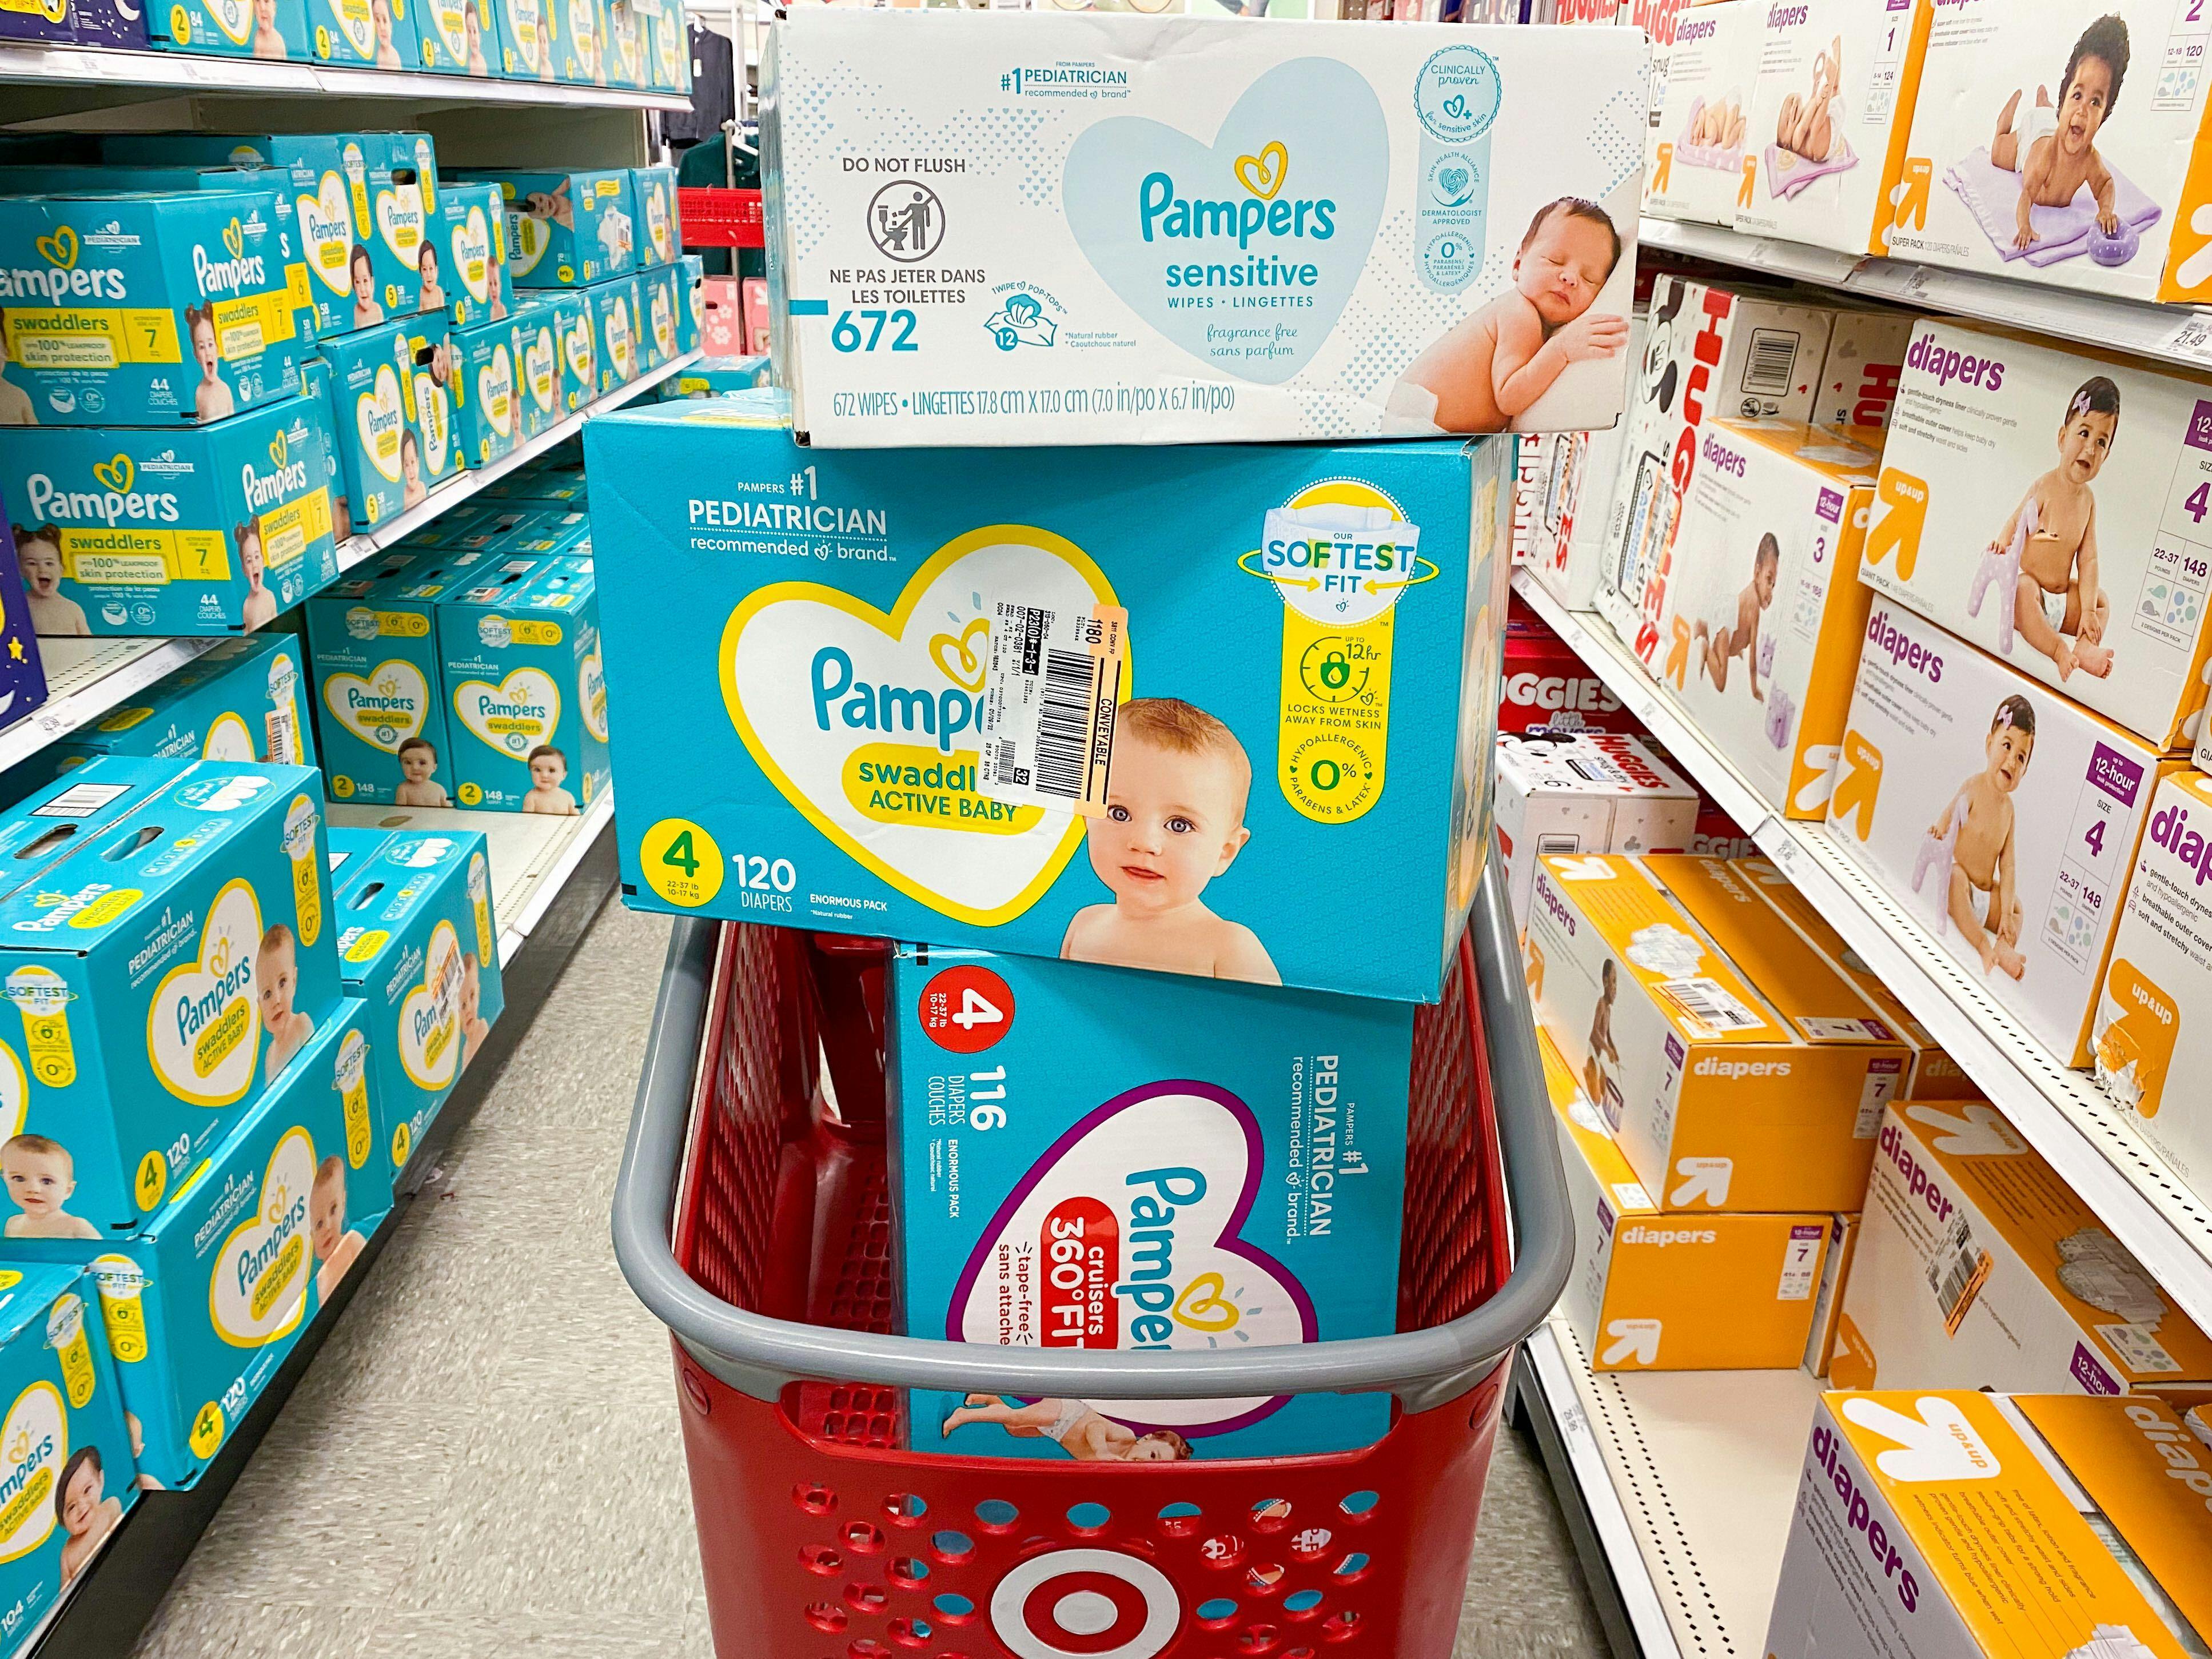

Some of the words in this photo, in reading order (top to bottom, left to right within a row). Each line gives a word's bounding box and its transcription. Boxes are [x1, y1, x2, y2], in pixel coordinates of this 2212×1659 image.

[1001, 68, 1022, 94] #1
[1025, 69, 1127, 84] PEDIATRICIAN
[1431, 65, 1486, 74] CLINICALLY
[1438, 75, 1480, 88] proven
[1025, 88, 1087, 98] recommended
[1425, 110, 1437, 125] for
[1438, 122, 1472, 133] sensitive
[1472, 113, 1487, 128] skin
[843, 158, 869, 173] DO
[874, 158, 909, 173] NOT
[915, 158, 966, 173] FLUSH
[1428, 165, 1437, 182] SKIN
[1436, 152, 1459, 165] HEALTH
[1460, 153, 1480, 183] ALLIANCE
[1140, 172, 1336, 250] Pampers
[193, 244, 265, 297] Pampers
[830, 270, 852, 284] NE
[857, 270, 886, 284] PAS
[891, 270, 936, 284] JETER
[942, 270, 986, 284] DANS
[1166, 255, 1318, 288] sensitive
[0, 268, 126, 306] ampers
[852, 290, 879, 304] LES
[886, 290, 966, 304] TOILETTES
[1167, 297, 1214, 308] WIPES
[1233, 296, 1314, 308] LINGETTES
[14, 314, 109, 331] swaddlers
[831, 310, 918, 353] 672
[1207, 324, 1270, 342] fragrance
[1274, 323, 1298, 341] free
[2174, 330, 2207, 346] 21.49
[998, 332, 1015, 346] 12
[1070, 340, 1111, 348] Caoutchouc
[1210, 345, 1241, 357] sans
[1246, 342, 1294, 360] parfum
[1908, 333, 2004, 391] diapers
[834, 392, 855, 417] 672
[858, 392, 897, 416] WIPES
[912, 391, 974, 416] LINGETTES
[977, 391, 998, 415] 17.8
[1001, 390, 1025, 414] cm
[1040, 390, 1061, 413] 17.0
[1065, 389, 1088, 413] cm
[1092, 388, 1113, 414] (7.0
[1117, 381, 1154, 416] in/po
[1171, 387, 1187, 410] 6.7
[1192, 380, 1234, 414] in/po)
[1703, 432, 1747, 478] diapers
[242, 460, 306, 513] Pampers
[738, 482, 785, 494] PAMPERS
[790, 465, 818, 501] #1
[26, 474, 179, 527] Pampers
[688, 499, 886, 535] PEDIATRICIAN
[70, 534, 161, 551] swaddlers
[691, 537, 808, 557] recommended
[1333, 533, 1353, 541] OUR
[1267, 540, 1415, 572] SOFTEST
[2184, 556, 2207, 578] 148
[80, 569, 103, 579] skin
[105, 569, 164, 580] protection
[1325, 575, 1362, 593] FIT
[201, 594, 218, 605] 44
[1085, 619, 1103, 644] 1180
[1868, 611, 1944, 683] diapers
[348, 688, 414, 711] Pampers
[478, 695, 545, 719] Pampers
[811, 647, 984, 751] Pamp
[1499, 673, 1623, 712] GGIES
[488, 721, 541, 732] swaddlers
[1285, 715, 1316, 725] AWAY
[1320, 718, 1351, 728] FROM
[1356, 720, 1381, 729] SKIN
[1288, 704, 1325, 715] LOCKS
[1329, 707, 1380, 718] WETNESS
[1094, 699, 1113, 766] CONVEYABLE
[1291, 733, 1372, 769] HYPOALLERGENIC
[357, 782, 374, 793] 148
[859, 762, 975, 791] swaddl
[1015, 769, 1029, 784] 32
[1311, 760, 1357, 791] 0%
[2096, 756, 2135, 792] 12-hour
[484, 790, 502, 800] 148
[870, 790, 950, 816] ACTIVE
[960, 799, 1017, 822] BABY
[1290, 776, 1332, 815] PARABENS
[2097, 799, 2111, 814] SIZE
[663, 830, 700, 878] 4
[2085, 820, 2106, 858] 4
[667, 880, 688, 890] 22-37
[691, 882, 699, 890] lb
[732, 854, 796, 893] 120
[2059, 871, 2080, 890] 22-37
[2149, 868, 2189, 901] gentle-touch
[668, 888, 688, 897] 10-17
[690, 890, 699, 900] kg
[741, 891, 792, 912] DIAPERS
[810, 893, 862, 908] ENORMOUS
[863, 898, 887, 911] PACK
[1536, 874, 1576, 938] diapers
[2082, 886, 2102, 909] 148
[2138, 909, 2150, 924] soft
[2151, 919, 2163, 933] and
[2163, 927, 2190, 954] stretchy
[2142, 893, 2175, 924] breathable
[2175, 915, 2193, 936] outer
[2194, 930, 2212, 952] cover
[129, 911, 193, 975] PEDIATRICIAN
[9, 986, 67, 999] SOFTEST
[176, 956, 250, 1046] Pampers
[2133, 982, 2173, 1026] up&up
[952, 988, 1003, 1030] 4
[197, 1004, 245, 1060] swaddlers
[1693, 1056, 1791, 1080] diapers
[928, 1076, 946, 1126] COUCHES
[948, 1075, 965, 1125] DIAPERS
[970, 1064, 1007, 1131] 116
[1289, 1056, 1304, 1168] recommended
[1345, 1103, 1355, 1146] PAMPERS
[166, 1133, 190, 1169] 120
[1309, 1055, 1338, 1235] PEDIATRICIAN
[144, 1158, 158, 1189] 4
[948, 1139, 958, 1191] ENORMOUS
[1338, 1150, 1369, 1174] #1
[1880, 1125, 1953, 1222] diaper
[948, 1193, 959, 1218] PACK
[237, 1195, 305, 1297] Pampers
[1622, 1226, 1716, 1247] diapers
[999, 1244, 1010, 1280] sans
[1115, 1167, 1207, 1349] Pampe
[1018, 1255, 1033, 1331] tape-free
[1088, 1246, 1108, 1335] cruisers
[999, 1286, 1013, 1345] attache
[1949, 1423, 1988, 1469] up&up
[1812, 1426, 1920, 1613] diapers
[1, 1598, 25, 1630] 104
